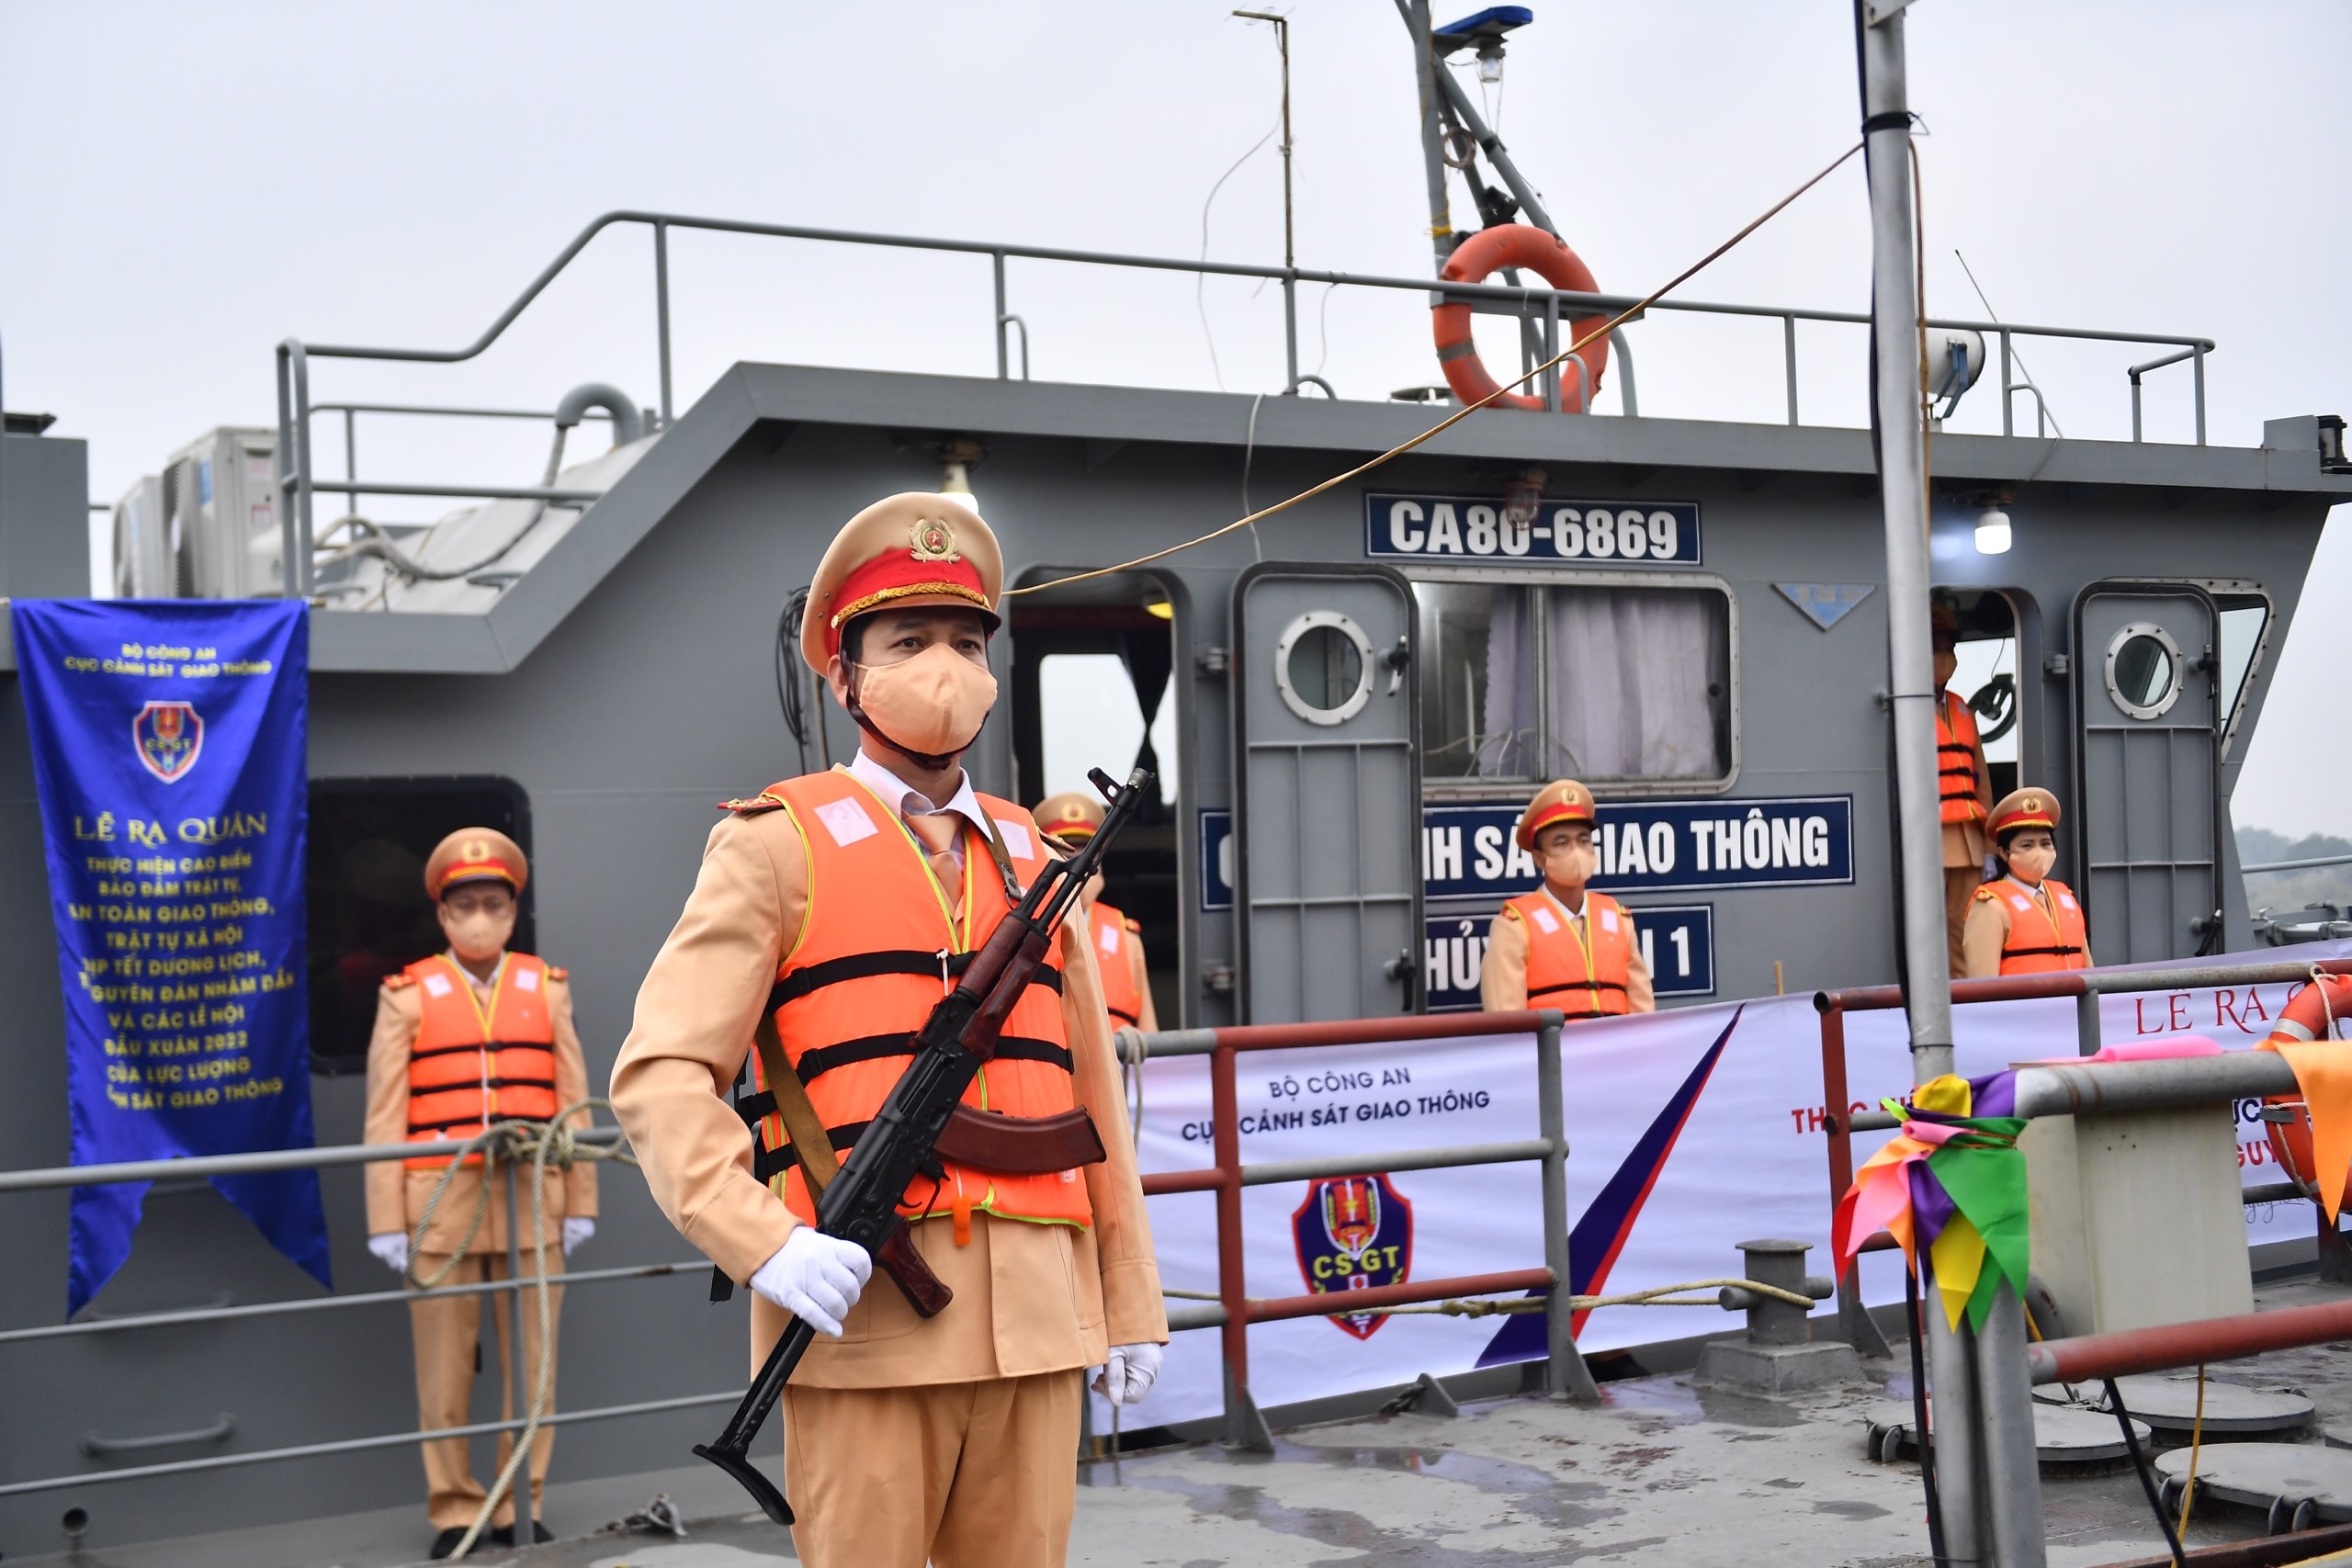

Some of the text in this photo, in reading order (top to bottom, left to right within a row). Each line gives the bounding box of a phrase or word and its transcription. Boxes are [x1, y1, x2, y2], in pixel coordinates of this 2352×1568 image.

[1390, 500, 1678, 559] CA80-6869
[128, 818, 168, 850] RA
[1690, 807, 1829, 872] THÔNG
[179, 856, 217, 874] CAO
[157, 904, 206, 923] GIAO
[1670, 926, 1690, 976] 1
[2214, 986, 2270, 1034] RA
[204, 1031, 248, 1053] 2022
[171, 1087, 220, 1108] GIAO
[1270, 1067, 1411, 1100] BỘ CÔNG AN
[1182, 1090, 1490, 1145] CỤ CẢNH SÁT GIAO THÔNG
